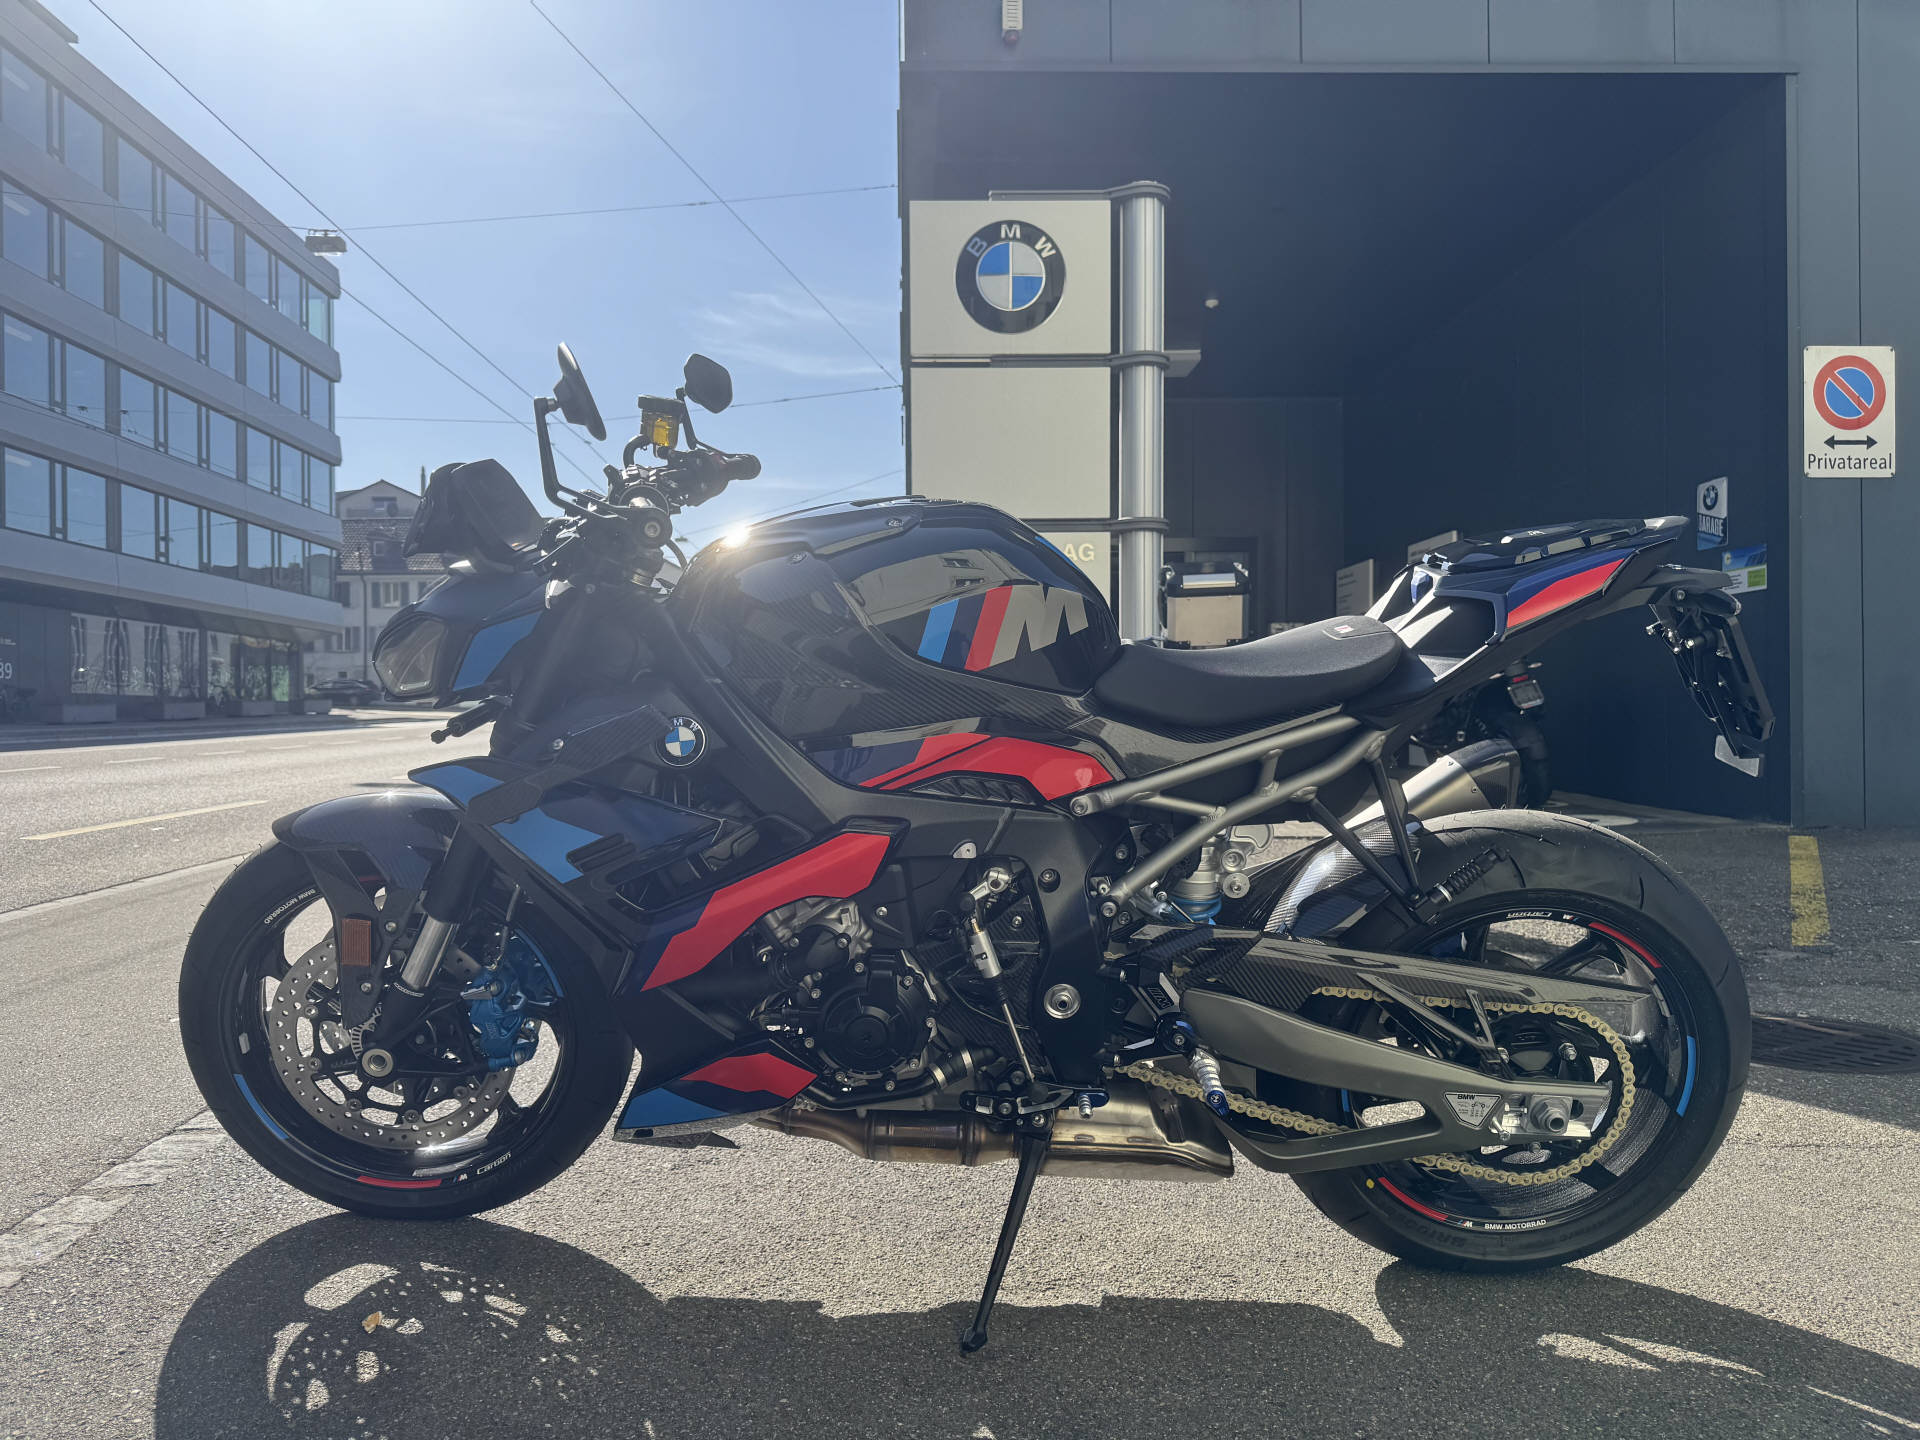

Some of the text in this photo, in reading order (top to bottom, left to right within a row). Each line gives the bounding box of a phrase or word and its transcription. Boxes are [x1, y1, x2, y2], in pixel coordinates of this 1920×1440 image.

[966, 223, 1057, 258] BMW
[1808, 452, 1892, 470] Privatareal
[1063, 543, 1095, 562] AG
[1457, 1093, 1476, 1101] BMW
[1484, 1222, 1504, 1231] BMW
[1504, 1219, 1547, 1231] MOTORRAD
